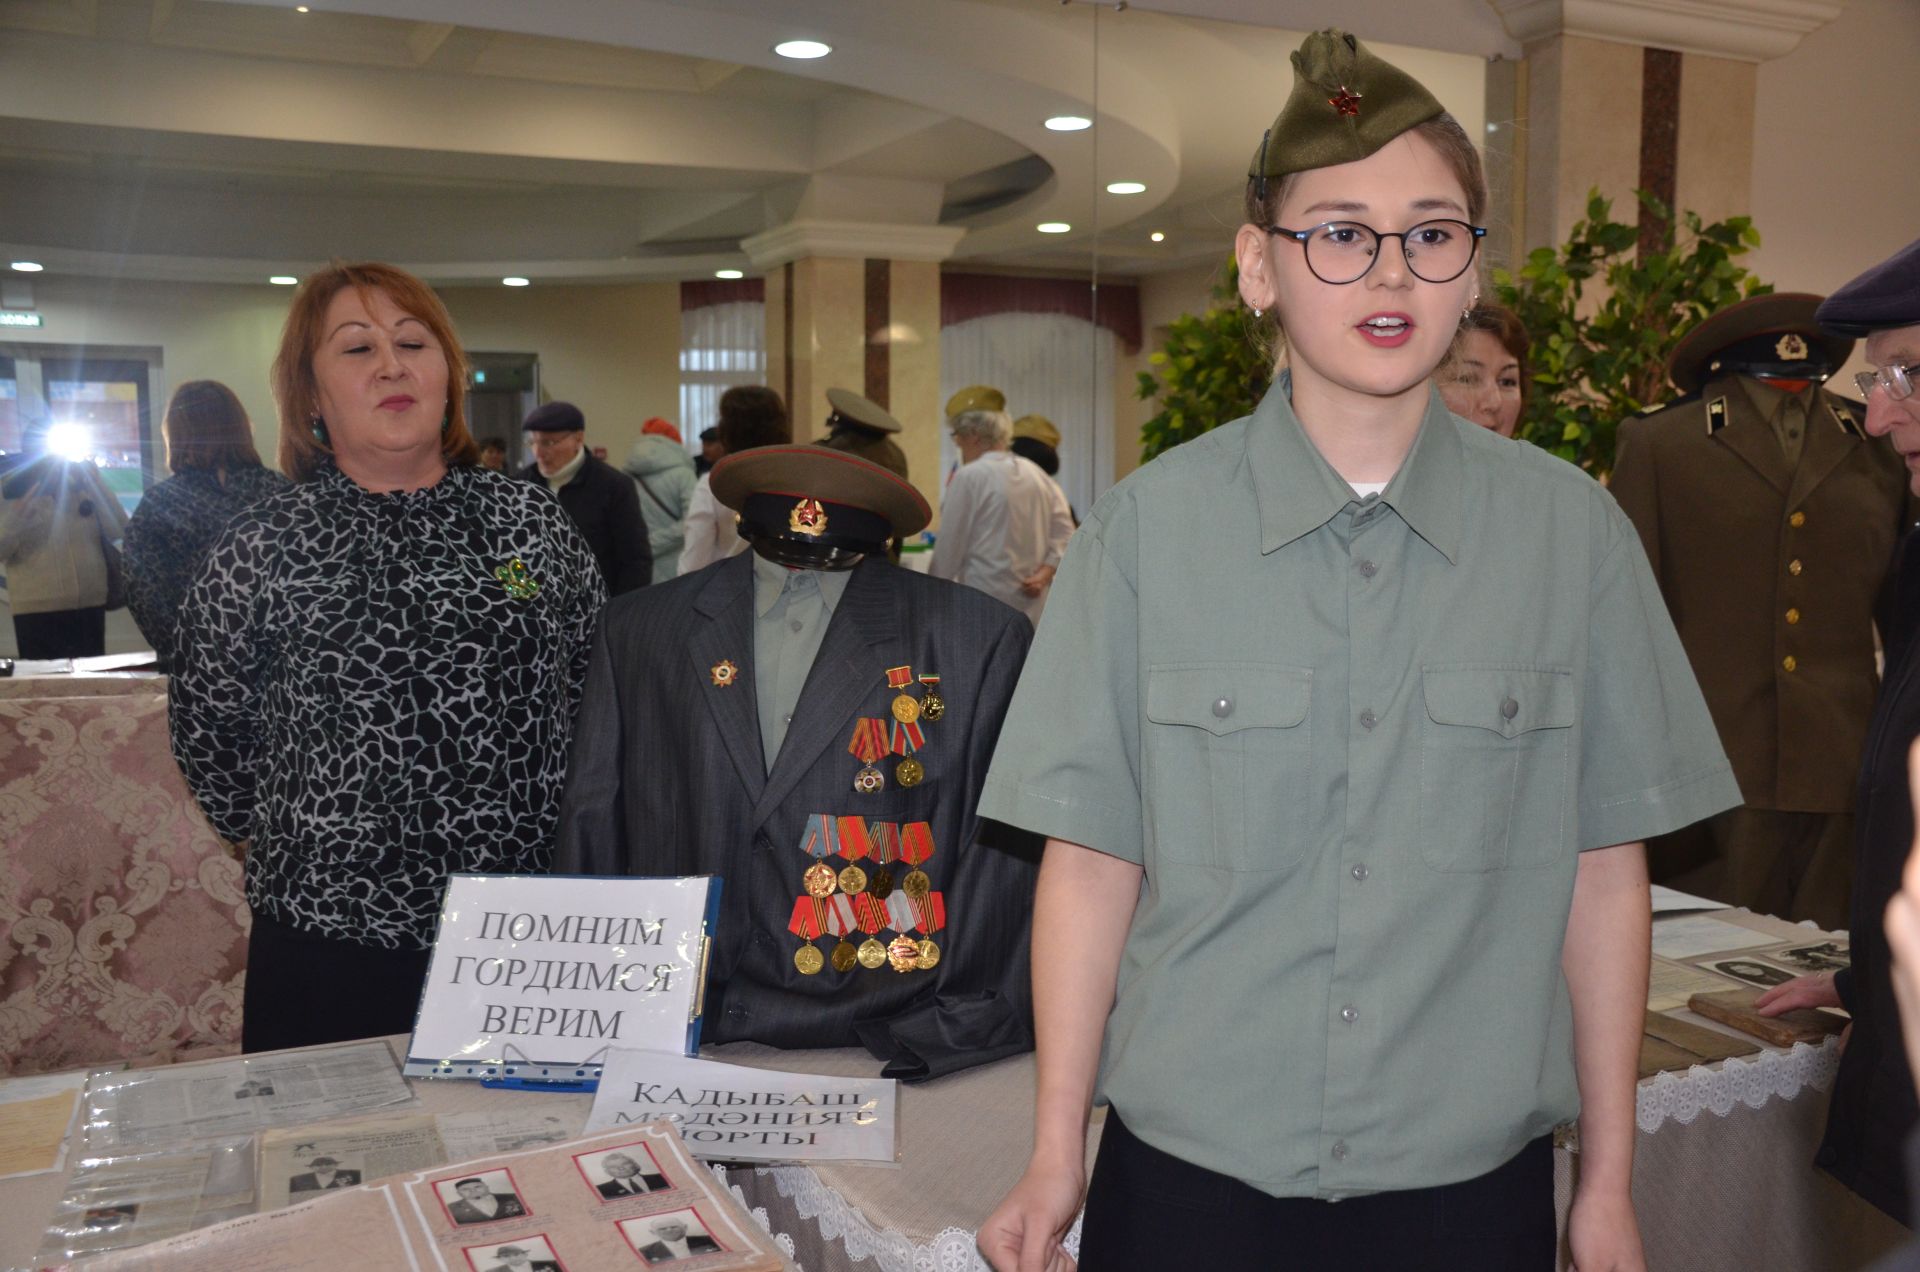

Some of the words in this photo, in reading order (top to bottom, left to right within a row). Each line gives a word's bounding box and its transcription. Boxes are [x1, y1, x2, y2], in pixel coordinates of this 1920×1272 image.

[476, 911, 668, 946] ПОМНИМ
[448, 956, 677, 996] ГОРДИМСЯ
[479, 1004, 625, 1040] ВЕРИМ
[633, 1081, 863, 1108] КАДЫБАШ
